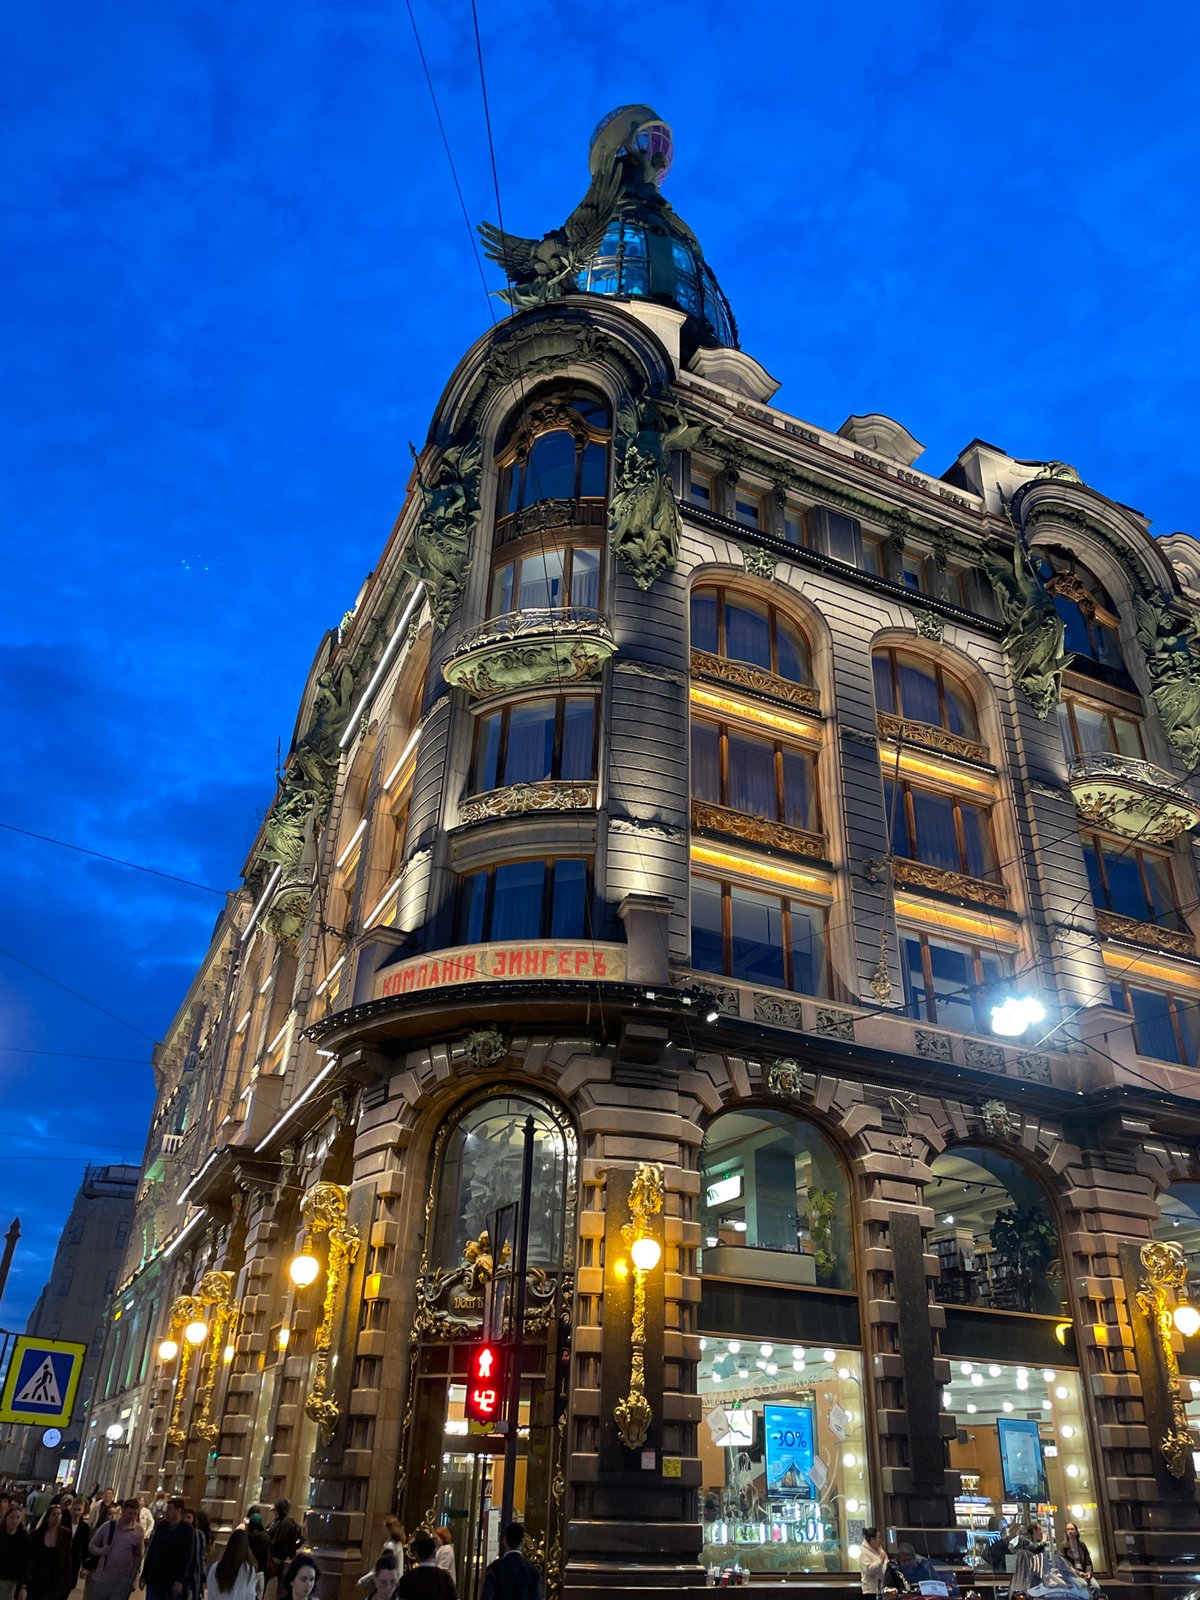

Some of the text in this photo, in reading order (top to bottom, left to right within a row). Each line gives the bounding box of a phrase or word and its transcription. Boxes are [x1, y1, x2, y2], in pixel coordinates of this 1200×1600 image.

[382, 951, 607, 998] КОМПАНІЯ ЗИНГЕРЪ
[473, 1390, 496, 1412] 42
[772, 1429, 807, 1448] -30%
